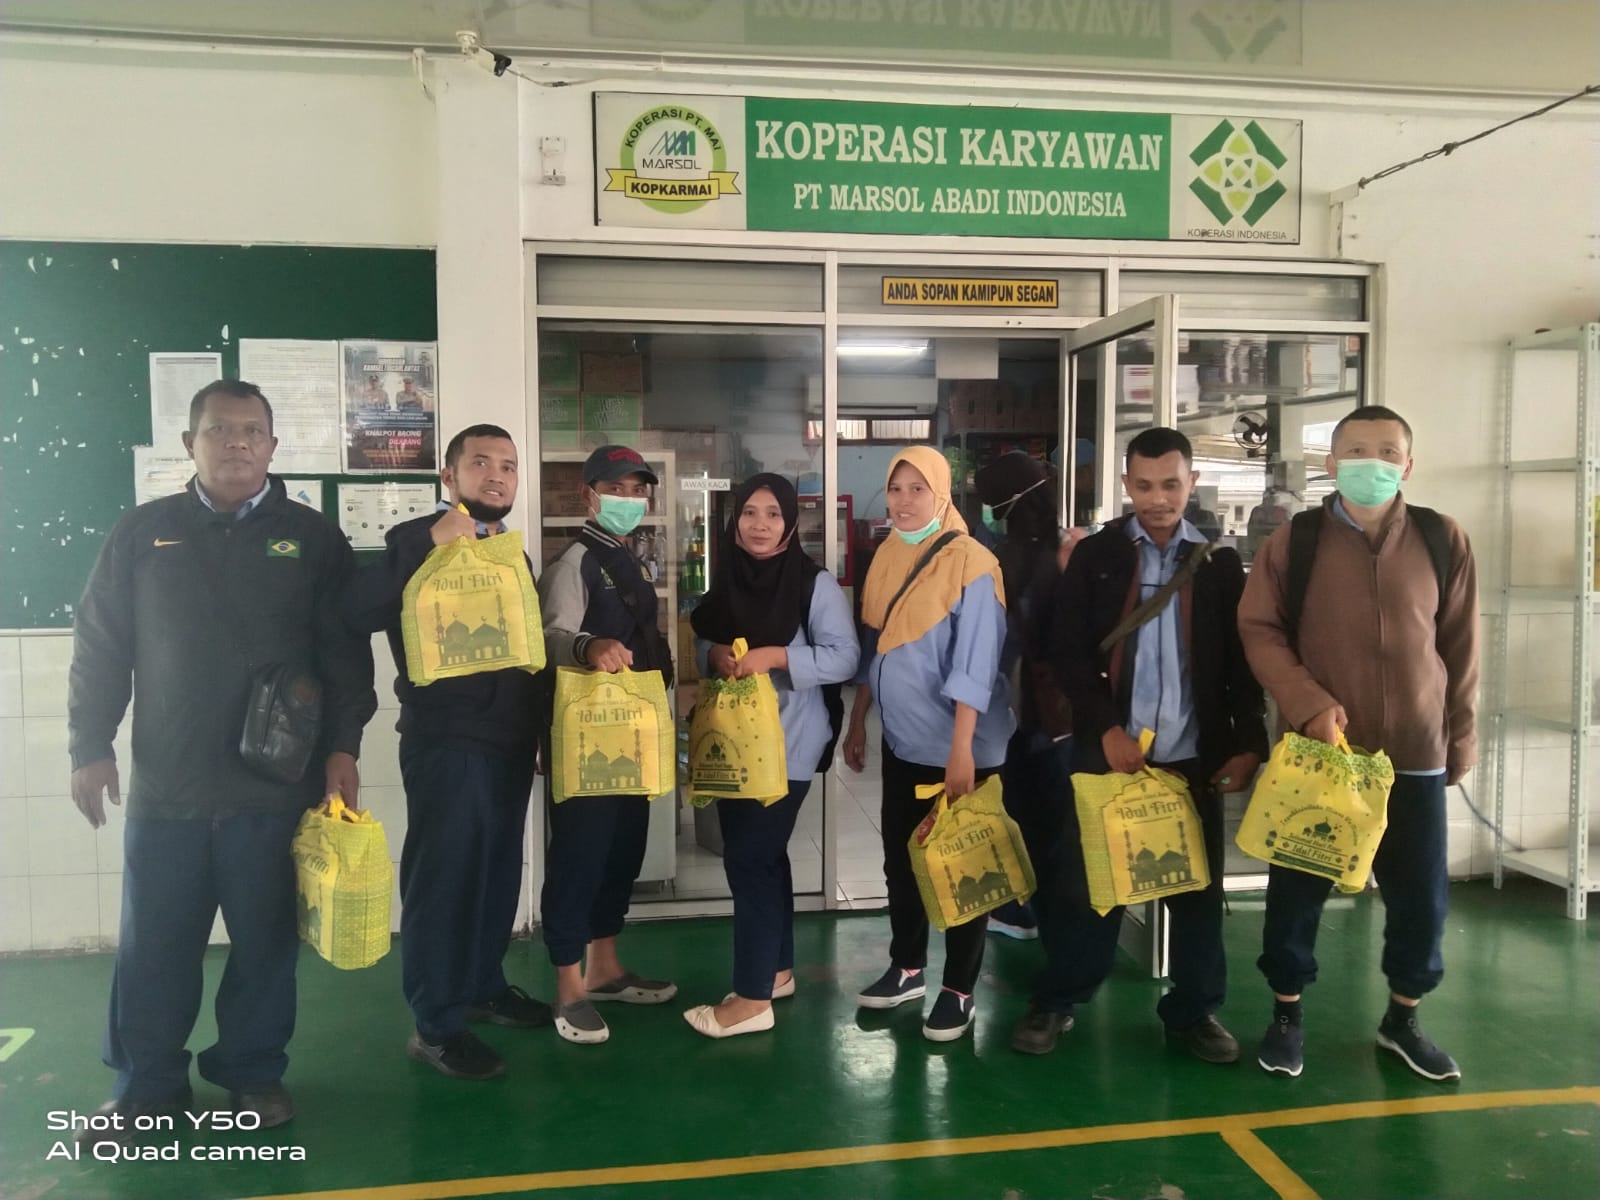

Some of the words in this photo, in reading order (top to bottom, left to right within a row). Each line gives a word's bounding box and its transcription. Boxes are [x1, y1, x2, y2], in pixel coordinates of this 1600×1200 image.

[625, 109, 682, 148] KOPERASI
[685, 112, 703, 128] PT.
[703, 127, 721, 151] MAI
[755, 120, 948, 165] KOPERASI
[960, 128, 1163, 171] KARYAWAN
[642, 158, 702, 170] MARSOL
[631, 182, 712, 196] KOPKARMAI
[793, 183, 823, 209] PT
[829, 185, 925, 213] MARSOL
[931, 187, 1000, 215] ABADI
[1007, 189, 1127, 218] INDONESIA
[1187, 228, 1235, 238] KOPERASI
[1238, 230, 1287, 240] INDONESIA
[887, 282, 918, 300] ANDA
[922, 283, 959, 301] SOPAN
[962, 284, 1014, 302] KAMIPUN
[1017, 285, 1054, 303] SEGAN
[684, 480, 706, 489] AWAS
[707, 480, 728, 489] KACA
[1292, 844, 1312, 858] Idul
[1311, 849, 1333, 863] Fitri
